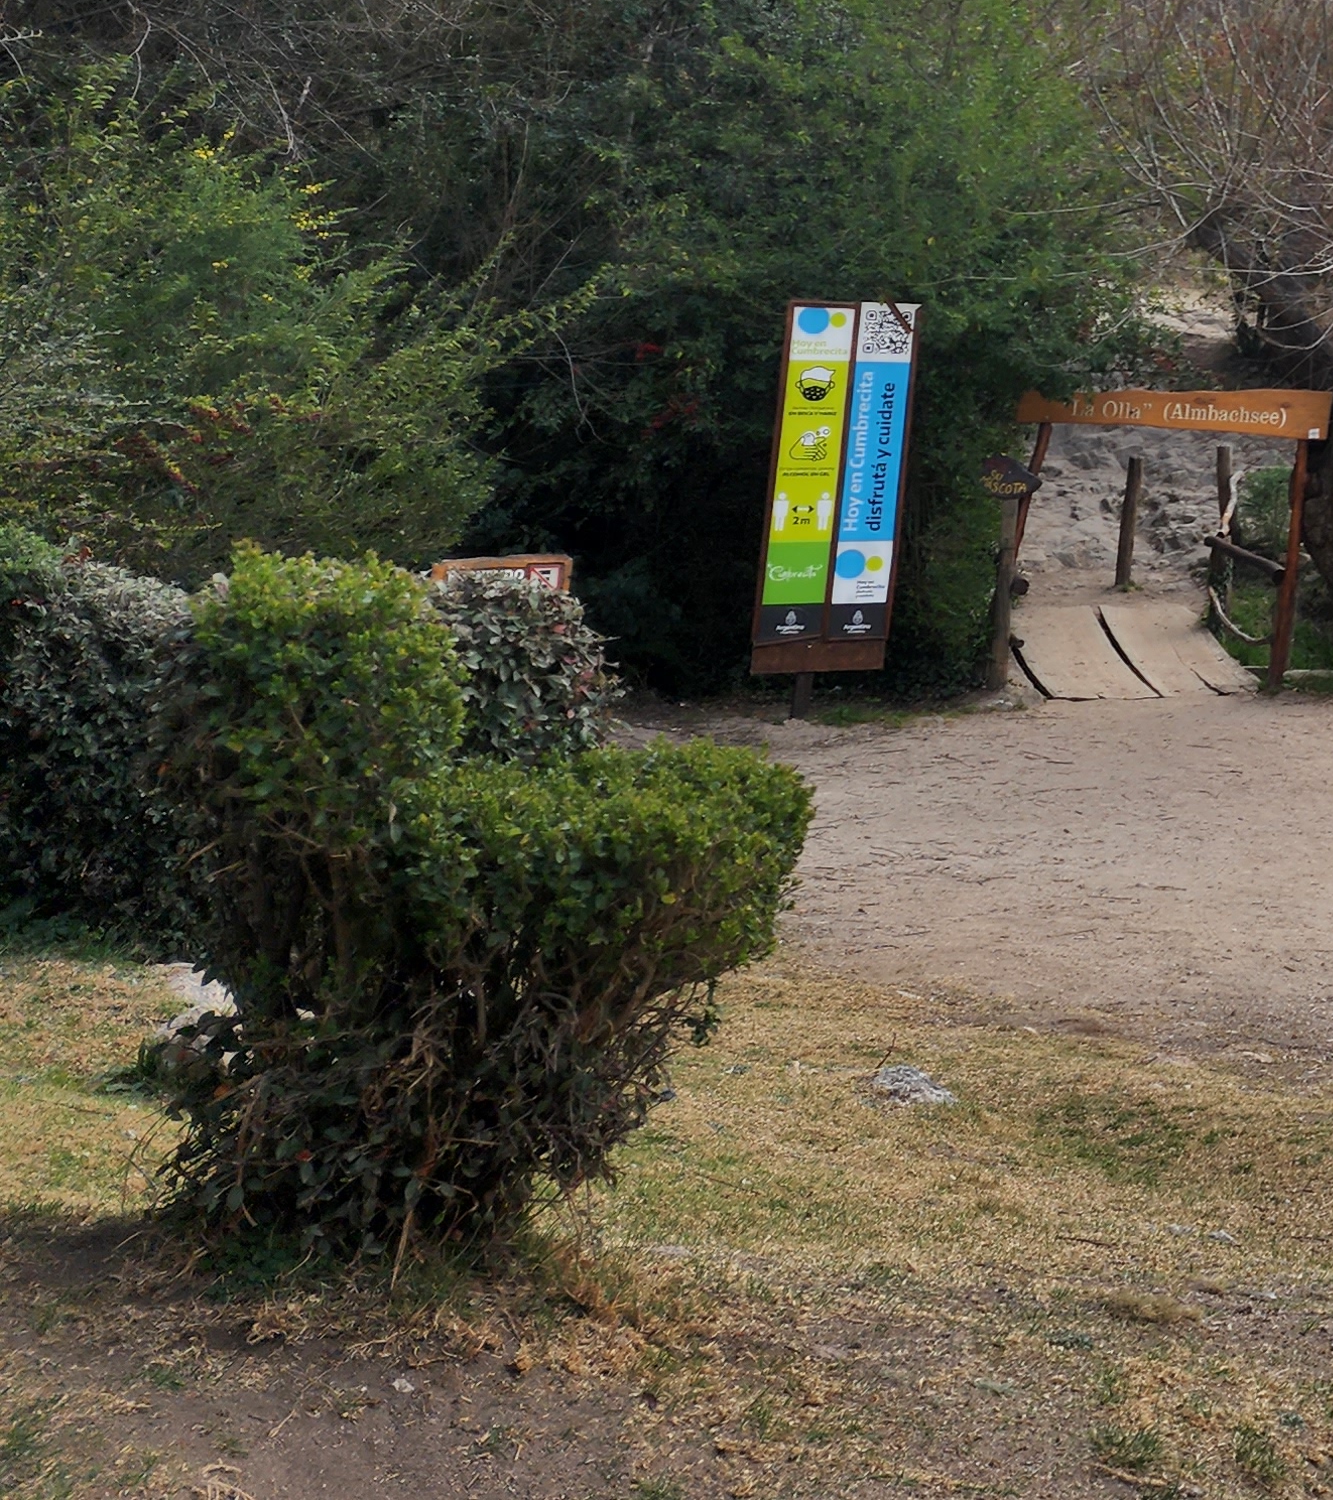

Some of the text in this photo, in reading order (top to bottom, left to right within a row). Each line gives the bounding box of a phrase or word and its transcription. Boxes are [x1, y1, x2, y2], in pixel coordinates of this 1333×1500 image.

[843, 371, 875, 532] Hoy en Cumbrecita
[865, 382, 896, 532] disfrutá y cuidate
[1163, 402, 1287, 429] (Almbachsee)
[793, 516, 799, 525] 2
